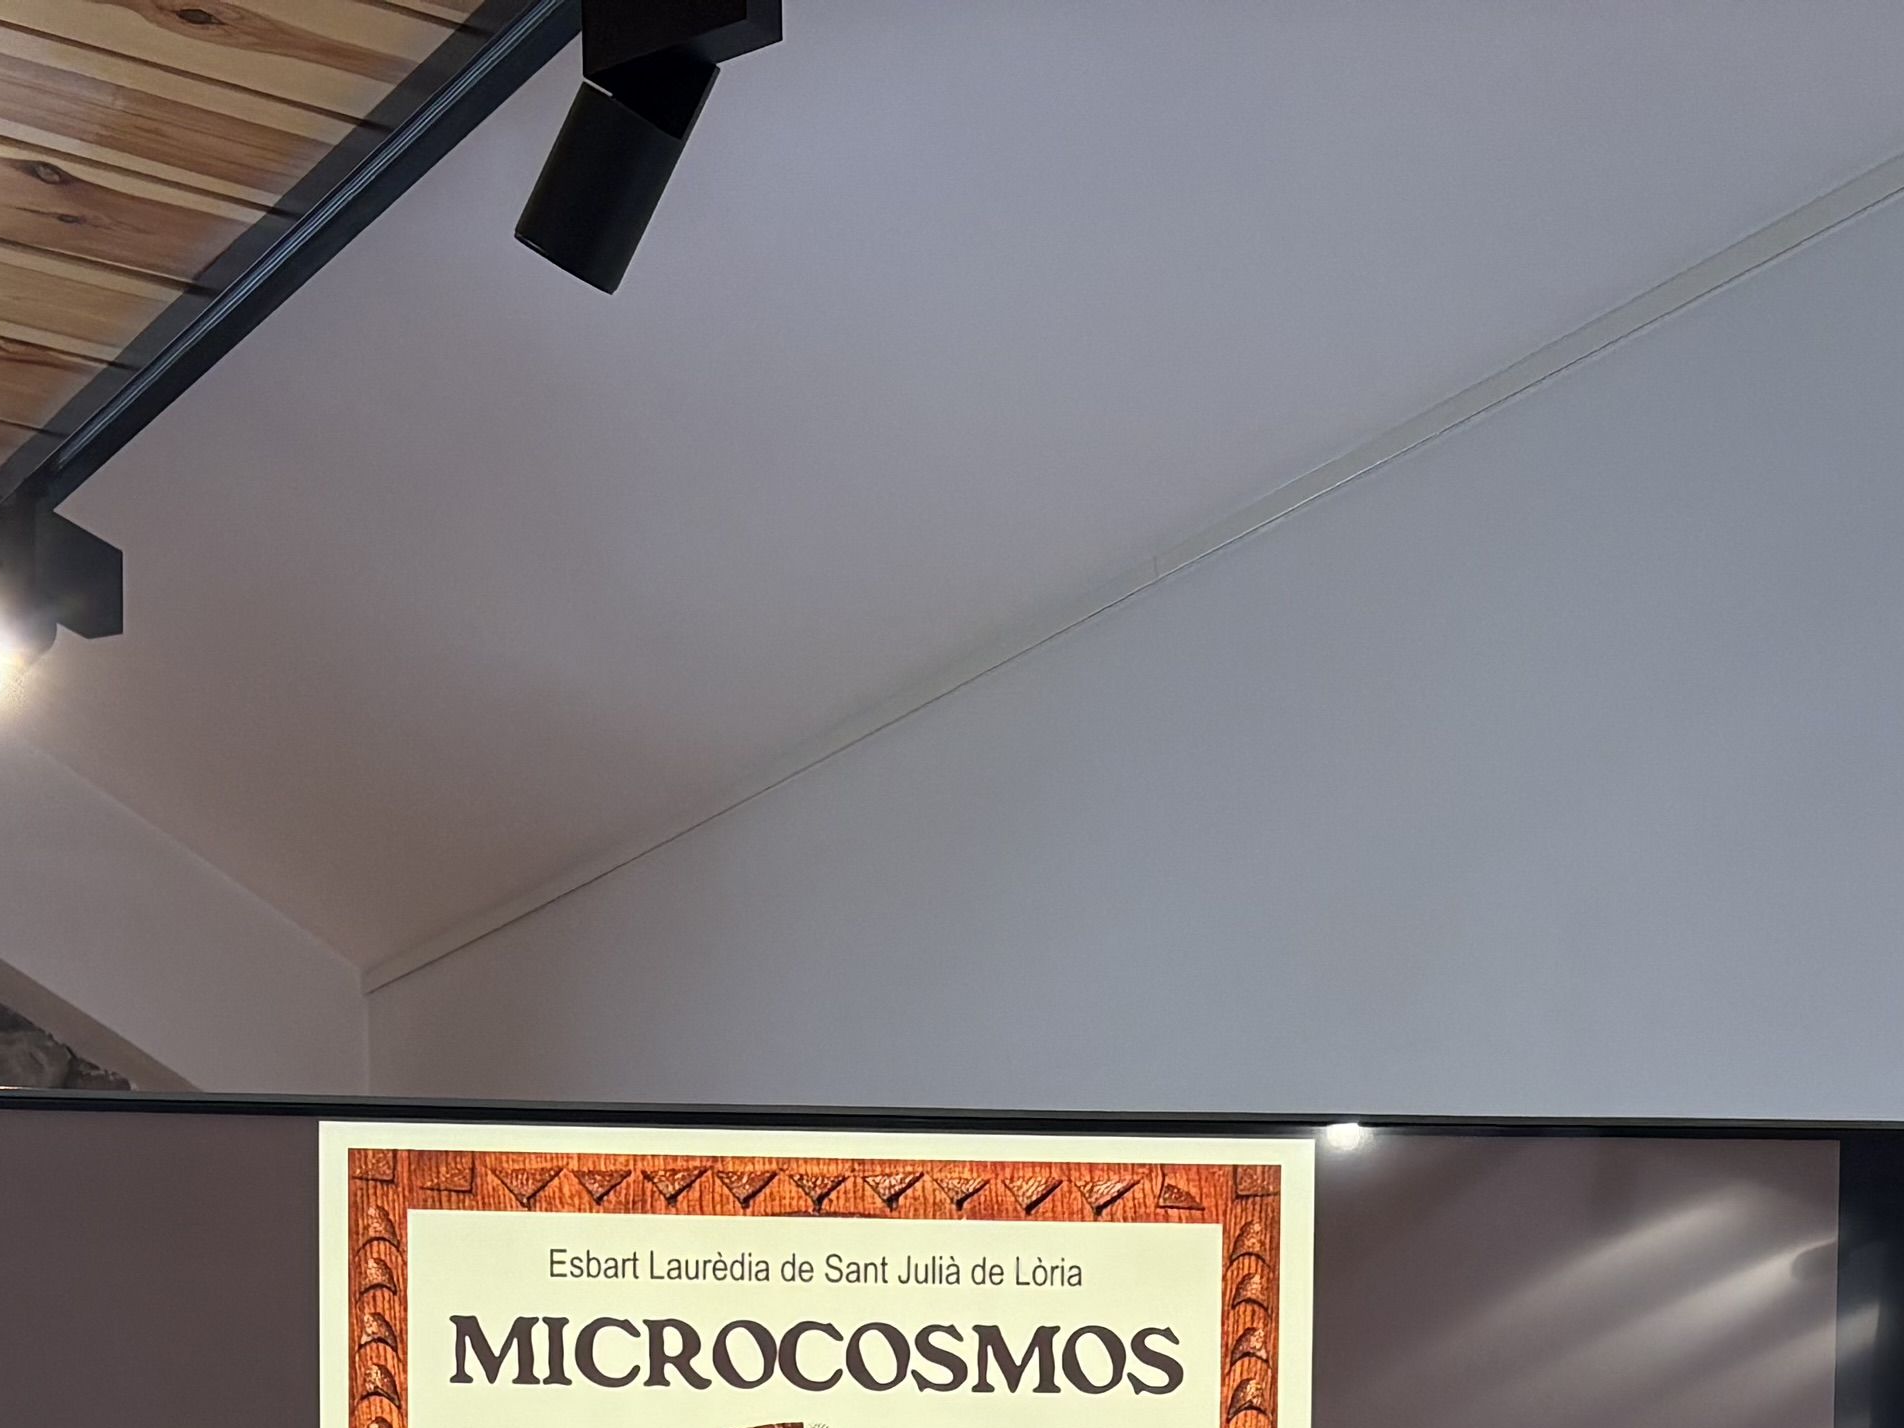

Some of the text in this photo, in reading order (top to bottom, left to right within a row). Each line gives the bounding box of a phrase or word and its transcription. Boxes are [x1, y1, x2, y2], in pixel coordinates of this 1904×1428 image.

[549, 1248, 1082, 1287] Esbart Laurèdia de Sant Julià de Lòria
[449, 1314, 1184, 1396] MICROCOSMOS
